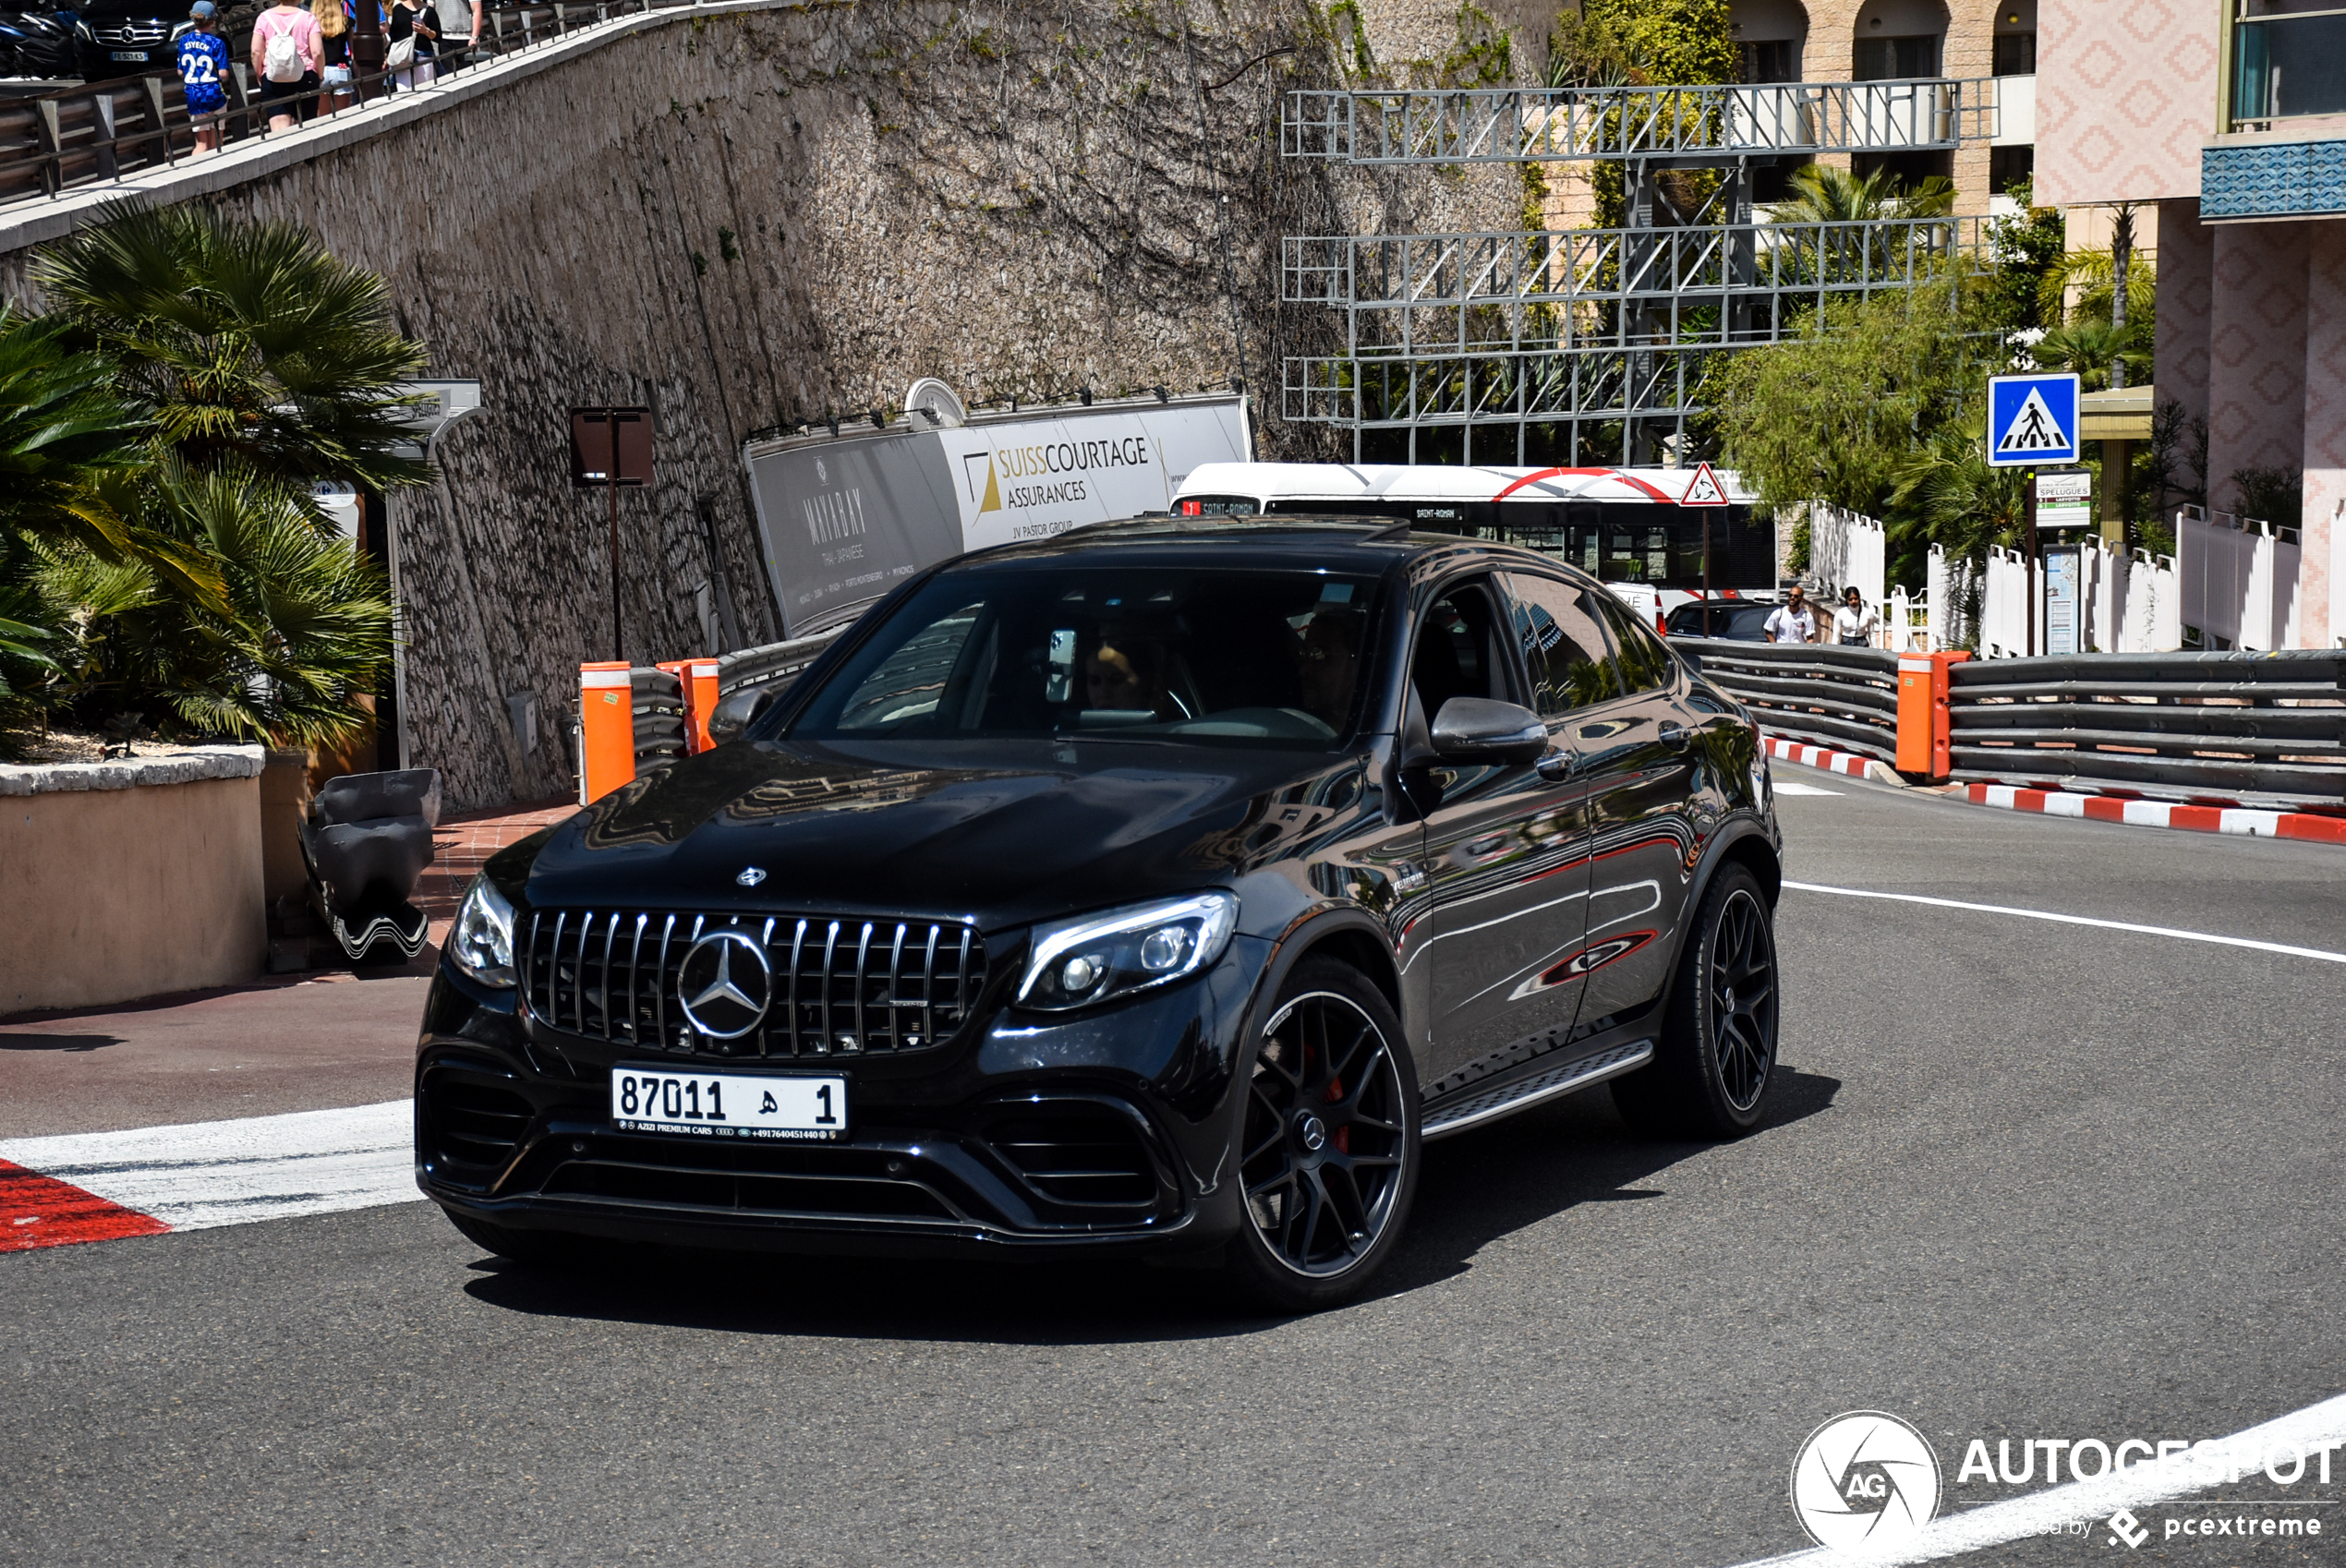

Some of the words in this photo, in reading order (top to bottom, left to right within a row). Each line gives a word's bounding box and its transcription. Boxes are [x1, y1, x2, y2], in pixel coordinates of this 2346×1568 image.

[185, 41, 211, 52] ZIYECH
[181, 54, 218, 84] 22
[998, 437, 1149, 478] SUISSCOURTAGE
[1008, 480, 1086, 509] ASSURANCES
[2039, 488, 2088, 496] SPELUGUES
[803, 488, 866, 546] MAYABAY
[1416, 509, 1455, 518] SAINT-ROMAN
[1013, 526, 1022, 538] JV
[1022, 523, 1048, 537] PASTOR
[1049, 520, 1073, 535] GROUP
[892, 564, 914, 577] MYKONOS
[621, 1076, 726, 1120] 87011
[816, 1084, 837, 1125] 1
[637, 1122, 656, 1131] AZIZI
[657, 1124, 691, 1134] PREMIUM
[692, 1126, 712, 1136] CARS
